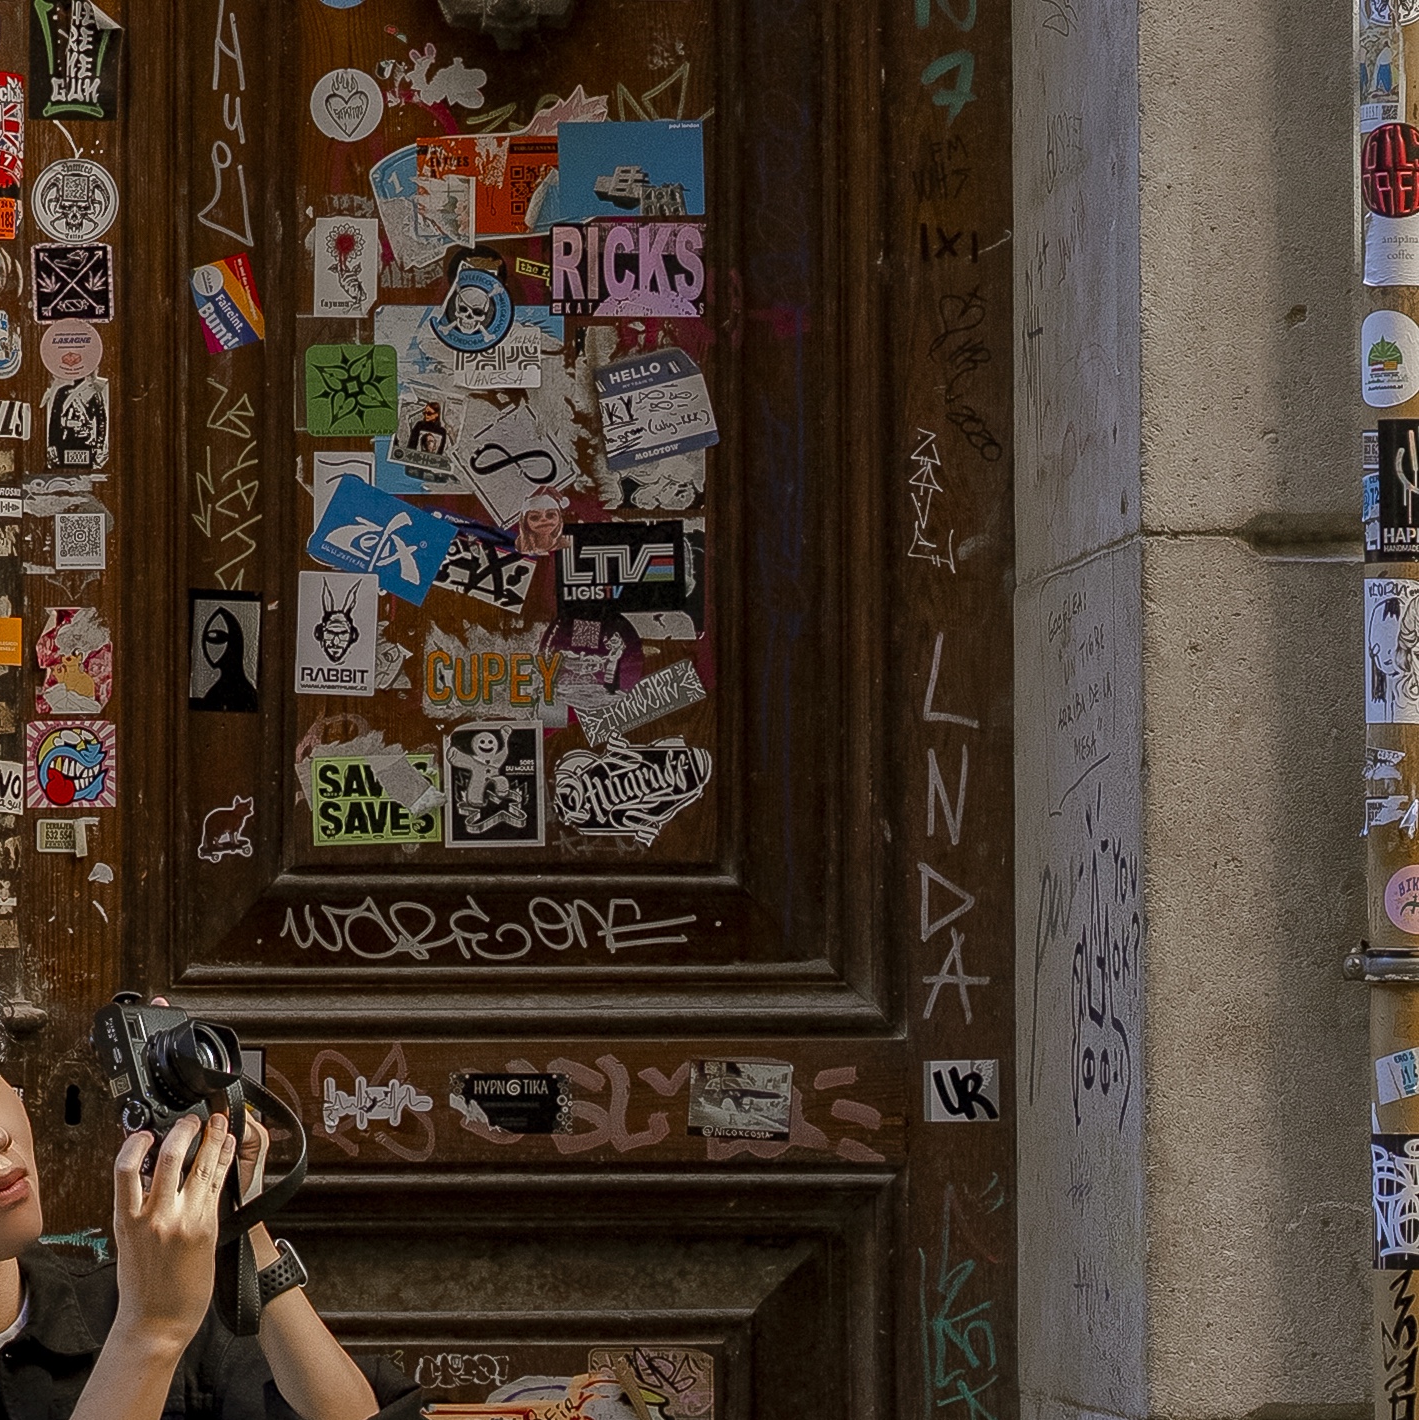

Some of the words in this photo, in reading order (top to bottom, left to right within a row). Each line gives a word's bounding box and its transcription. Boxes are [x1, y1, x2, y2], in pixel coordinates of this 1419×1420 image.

[3, 153, 13, 166] 7
[0, 213, 15, 227] 183
[552, 225, 705, 300] RICKS
[1386, 249, 1415, 261] coffee
[520, 262, 538, 274] the
[198, 301, 240, 351] Bunt!
[51, 335, 92, 345] LASAGNE
[464, 370, 525, 387] VANESSA
[608, 362, 661, 385] HELLO
[634, 443, 681, 461] MOLOTOW
[562, 534, 675, 585] LTV
[563, 584, 623, 601] LIGISTV
[300, 666, 369, 684] RABBIT
[426, 649, 564, 705] CUPEY
[1074, 730, 1098, 764] MESA
[318, 802, 435, 836] SAVES
[473, 1078, 550, 1096] HYPNOTIKA
